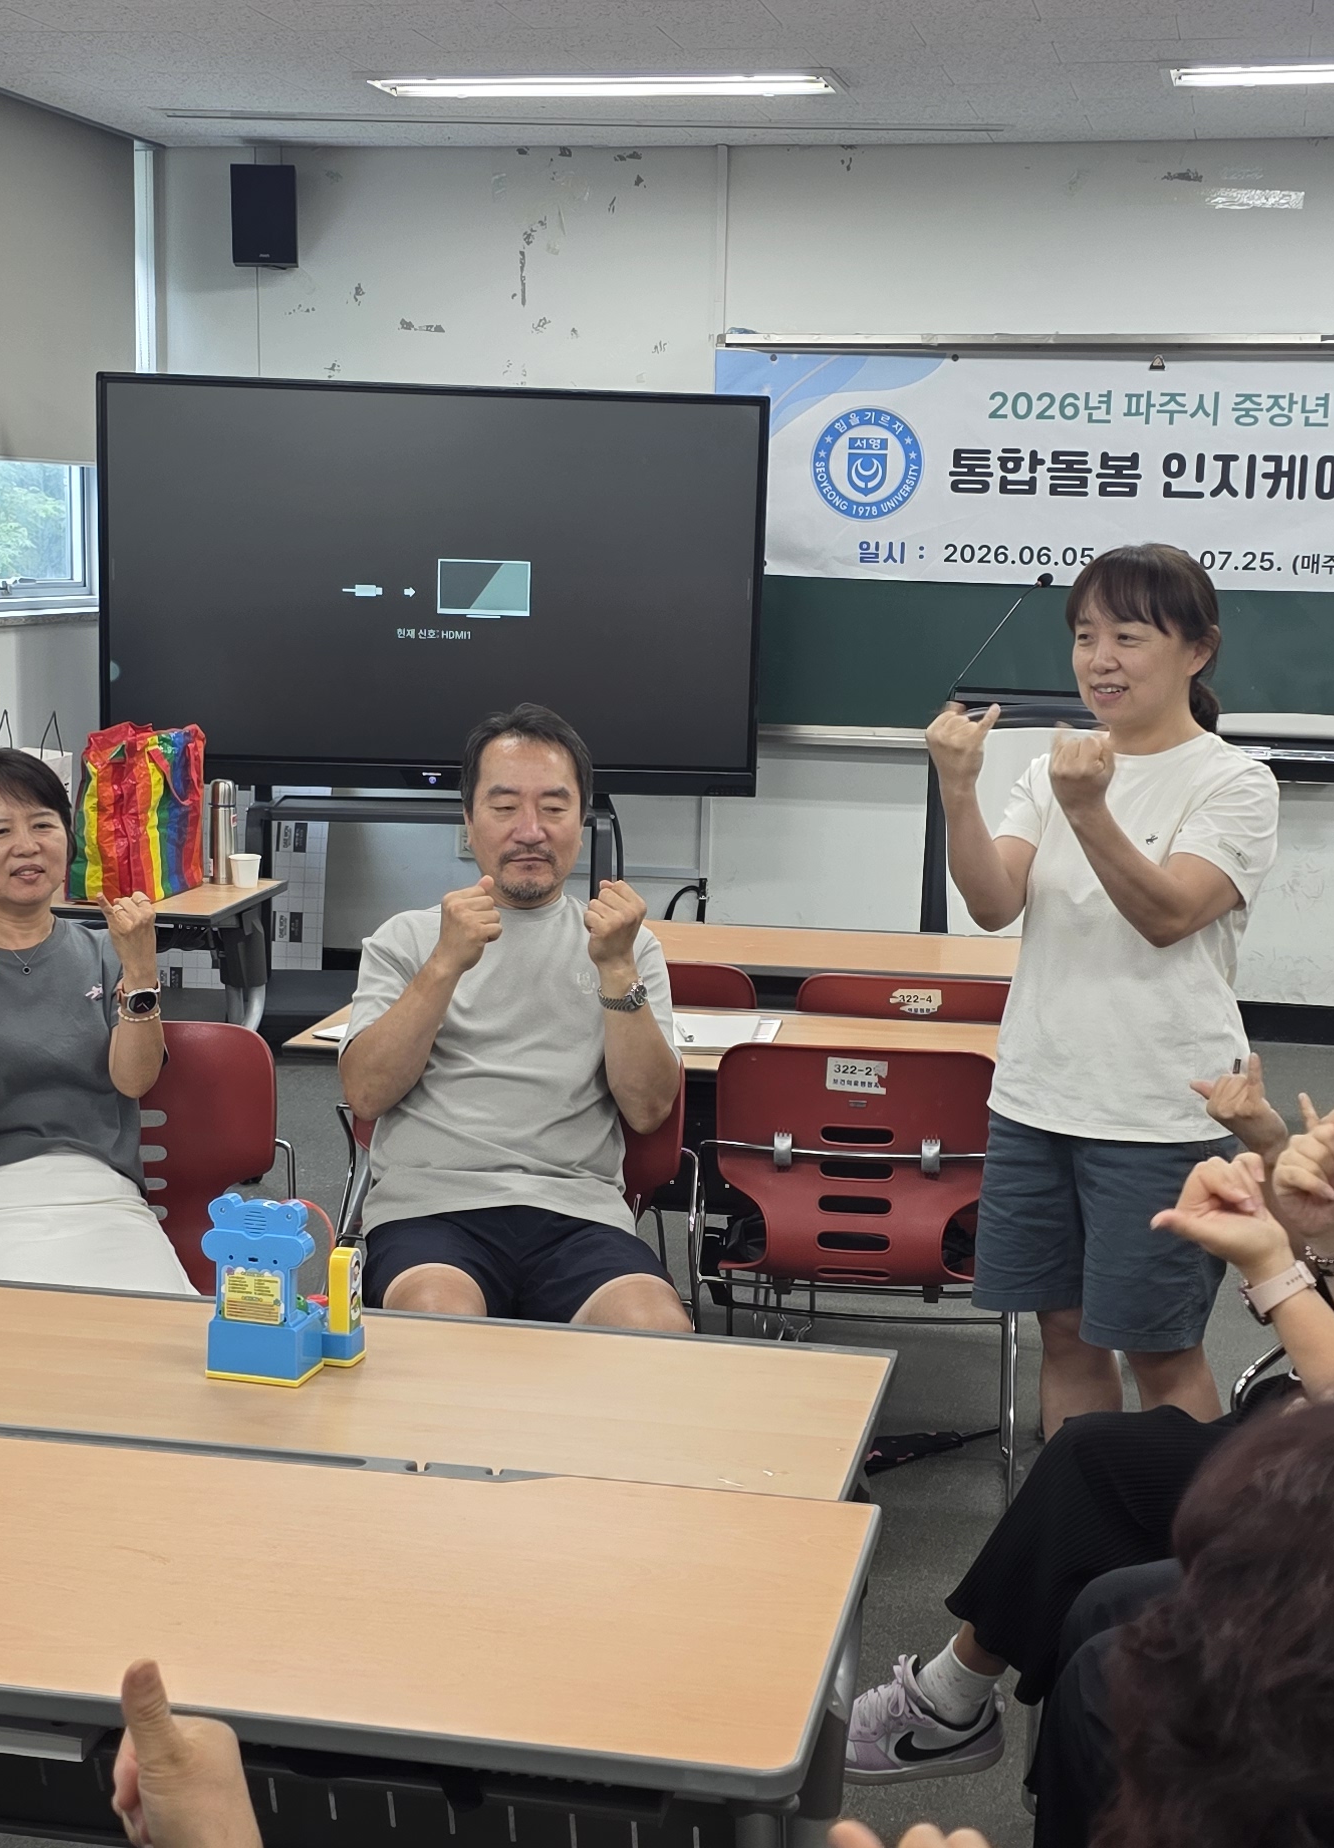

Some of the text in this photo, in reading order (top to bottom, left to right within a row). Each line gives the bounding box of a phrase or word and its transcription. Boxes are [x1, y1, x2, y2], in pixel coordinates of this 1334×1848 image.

[988, 390, 1112, 424] 2026년
[1123, 391, 1219, 426] 파주시
[1232, 393, 1330, 428] 중장년
[854, 438, 881, 450] 서영
[949, 448, 1142, 497] 통합돌봄
[815, 461, 919, 516] SEOYEONG 1978 UNIVERSITY
[859, 541, 905, 564] 일시
[397, 628, 416, 639] 현재
[441, 630, 471, 640] HDMI1
[834, 1064, 878, 1076] 322-2
